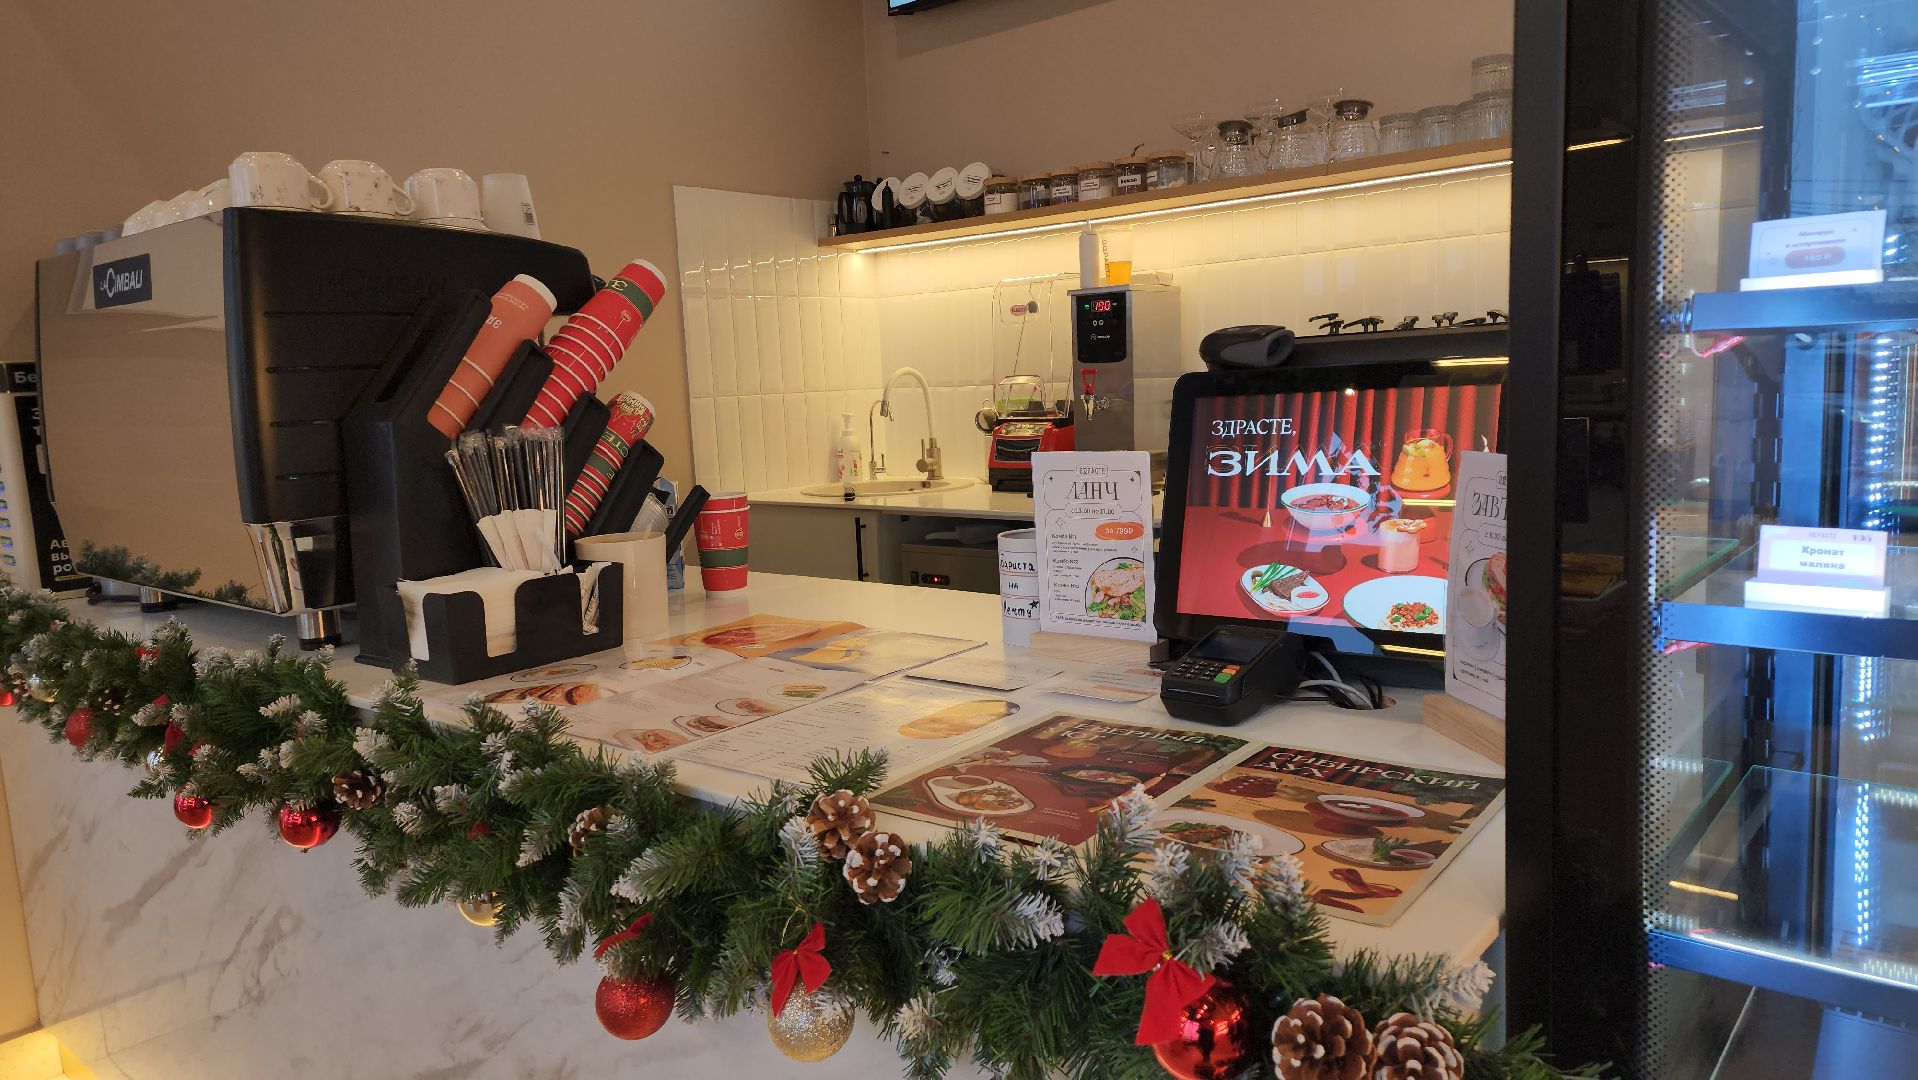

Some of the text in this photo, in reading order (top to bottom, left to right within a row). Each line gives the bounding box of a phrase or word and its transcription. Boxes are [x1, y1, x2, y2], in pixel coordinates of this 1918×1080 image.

[1211, 418, 1297, 439] ЗДРАСТЕ,
[1207, 448, 1382, 477] ЗИМА
[1065, 481, 1120, 501] ЛАНЧ
[1801, 545, 1845, 557] Кронат
[1799, 560, 1846, 570] малина
[1253, 760, 1325, 778] ДУХ
[1271, 752, 1482, 790] СИБИРСКИЙ
